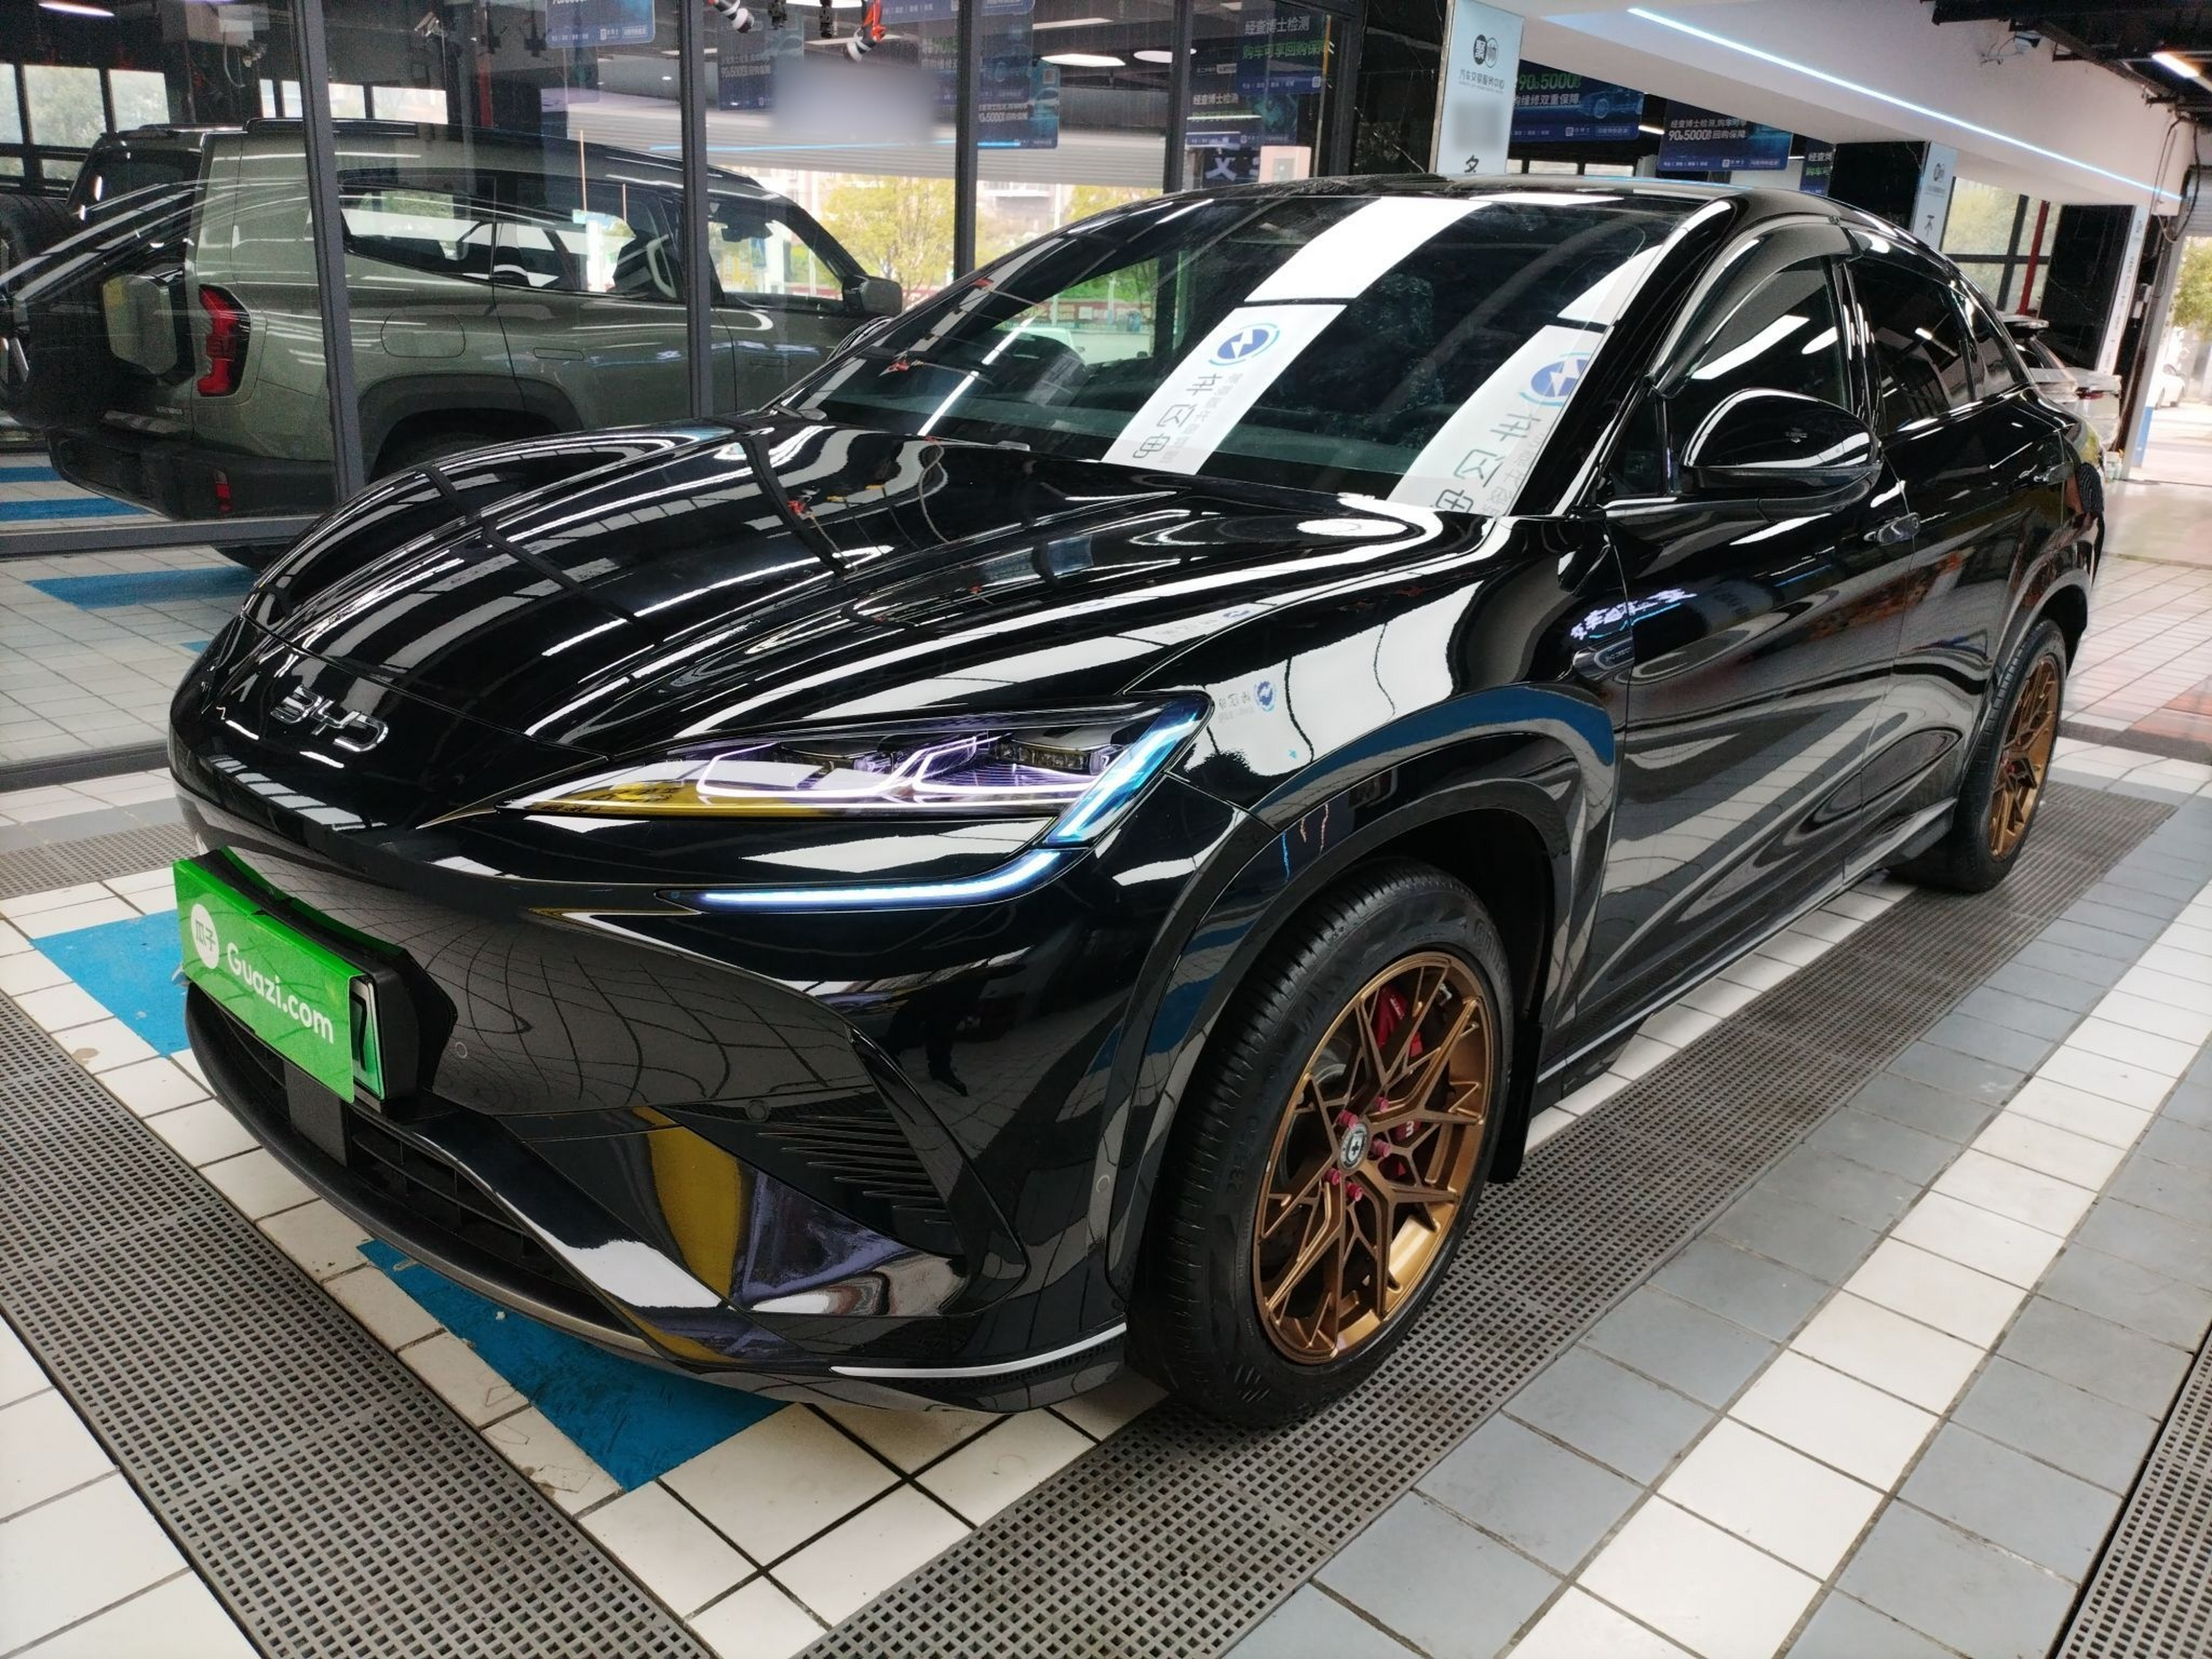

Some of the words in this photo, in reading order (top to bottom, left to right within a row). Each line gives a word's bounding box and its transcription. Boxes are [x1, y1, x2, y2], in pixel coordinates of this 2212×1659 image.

[270, 684, 388, 752] BYD
[195, 919, 217, 952] 瓜子
[227, 941, 334, 1045] Guazi.com
